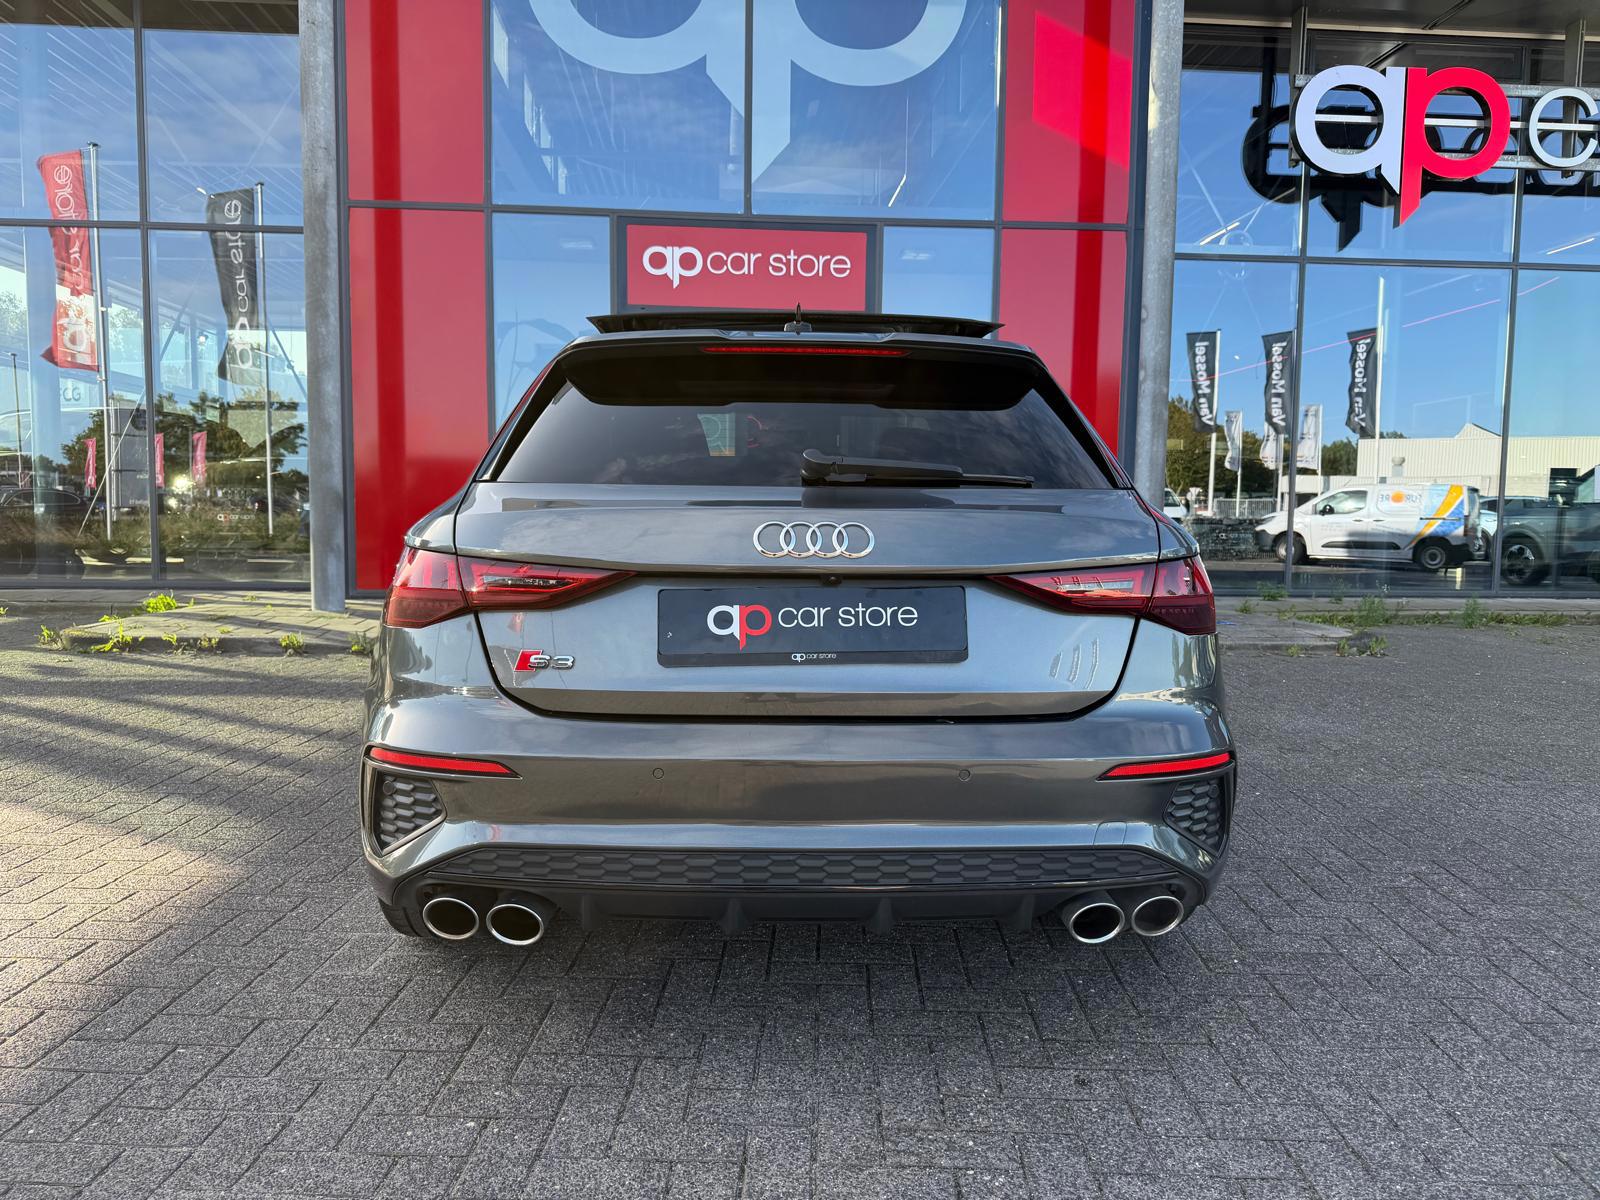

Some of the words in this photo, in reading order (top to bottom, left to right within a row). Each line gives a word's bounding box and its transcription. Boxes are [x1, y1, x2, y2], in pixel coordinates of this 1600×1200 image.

[1295, 65, 1511, 225] ap
[642, 245, 703, 288] ap
[707, 250, 762, 275] car
[768, 249, 851, 278] store
[706, 604, 772, 650] ap
[778, 606, 832, 628] car
[838, 602, 918, 627] store
[528, 654, 575, 670] S3
